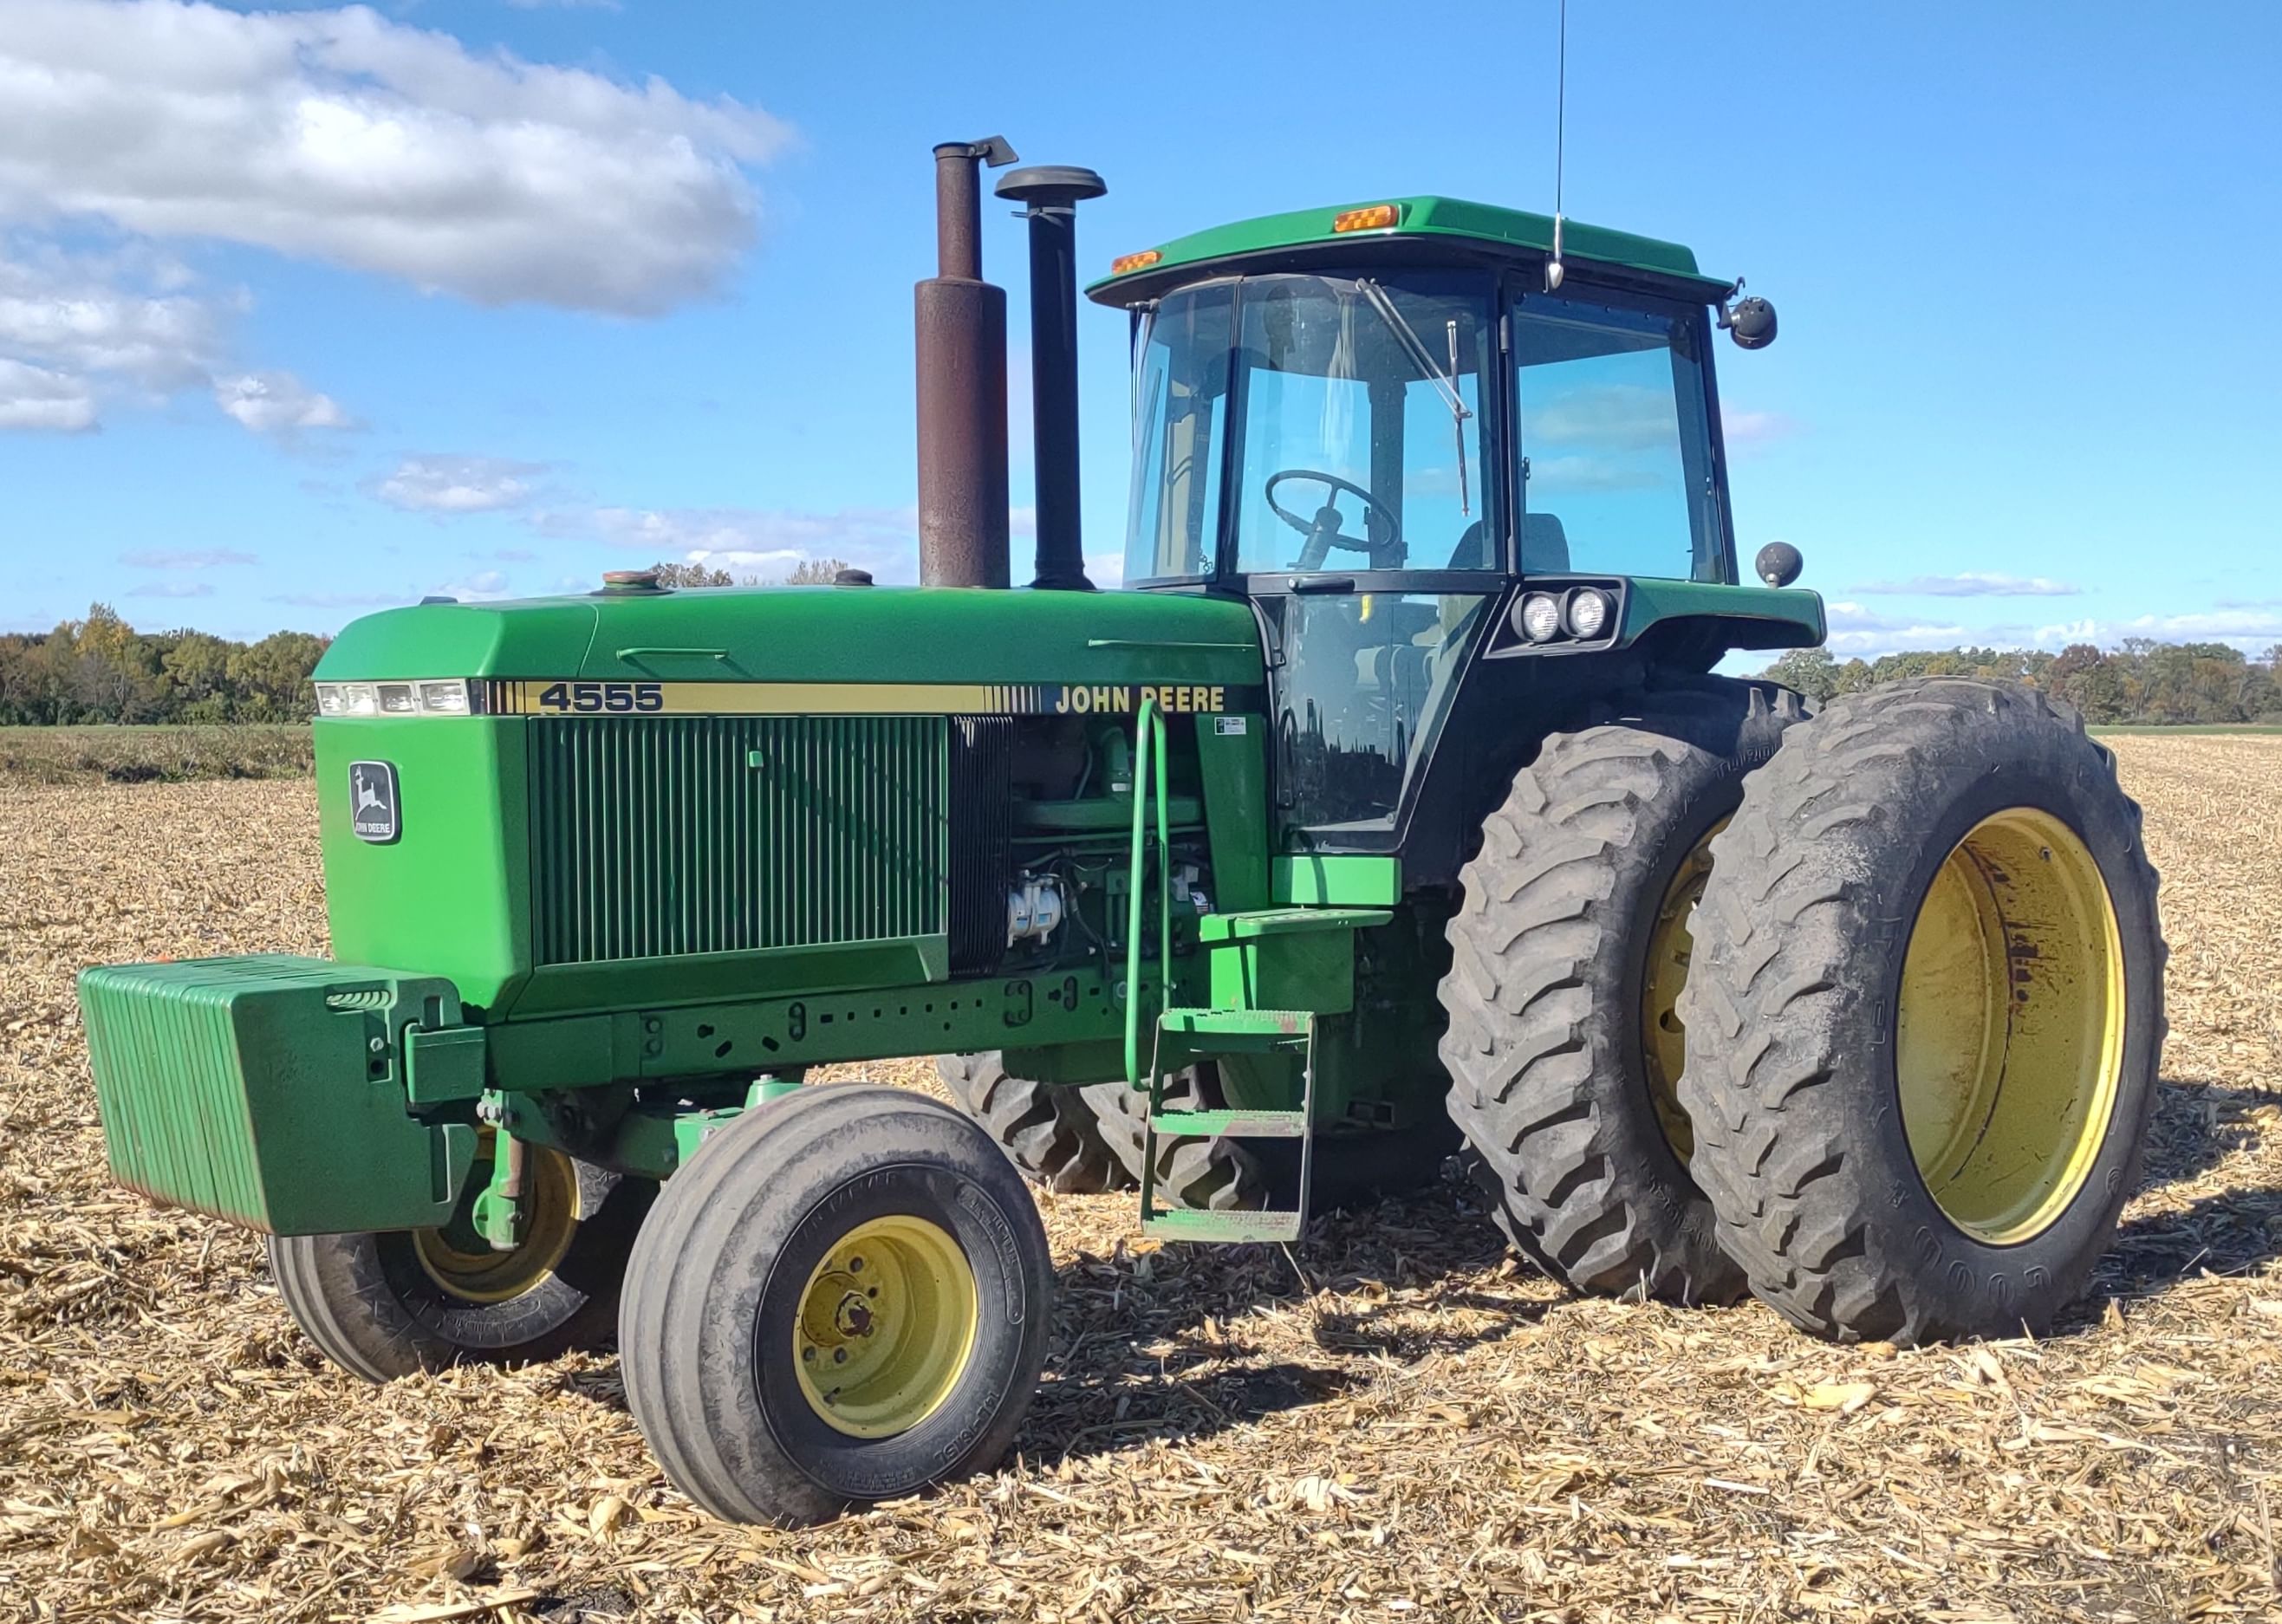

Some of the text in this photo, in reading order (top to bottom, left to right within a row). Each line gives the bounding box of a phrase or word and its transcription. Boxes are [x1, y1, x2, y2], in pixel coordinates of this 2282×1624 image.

[539, 682, 664, 712] 4555
[1055, 685, 1130, 714] JOHN
[367, 822, 391, 834] DEERE
